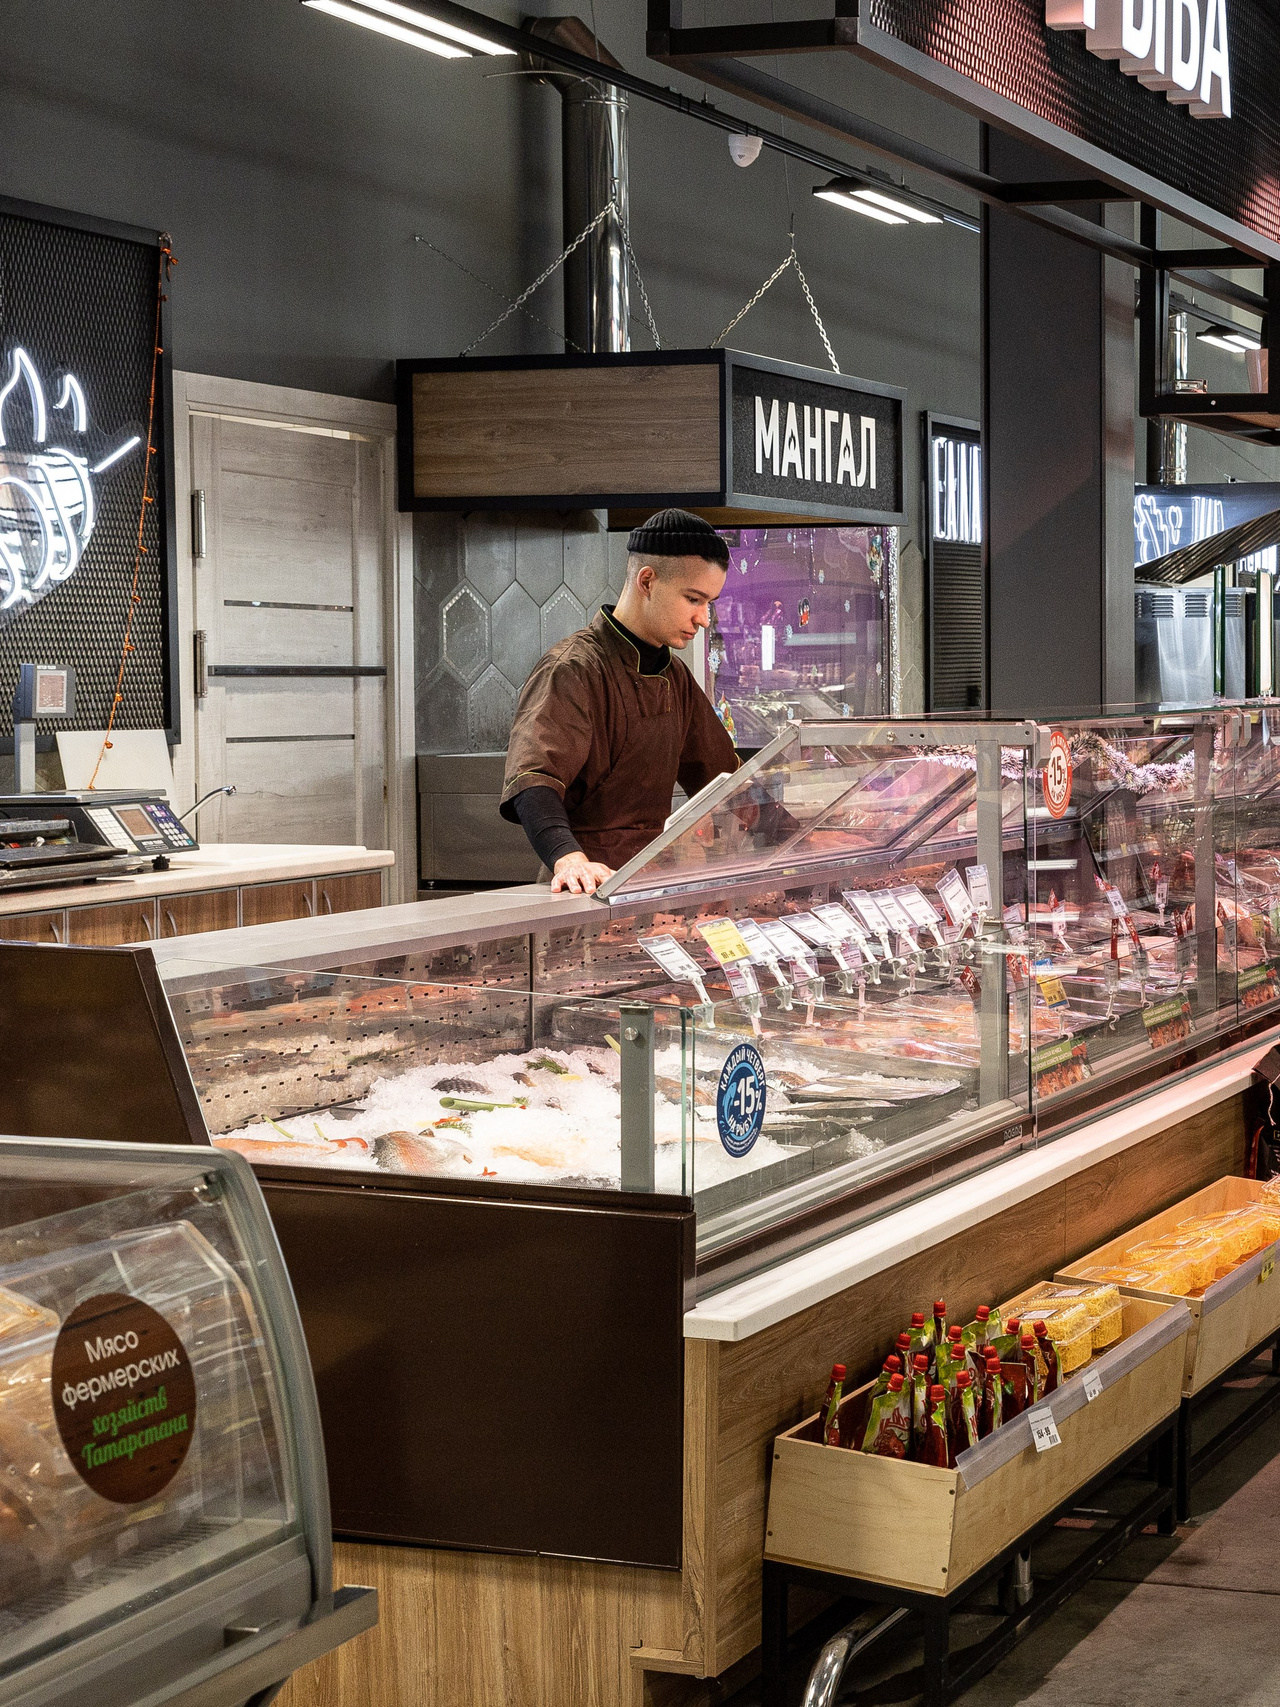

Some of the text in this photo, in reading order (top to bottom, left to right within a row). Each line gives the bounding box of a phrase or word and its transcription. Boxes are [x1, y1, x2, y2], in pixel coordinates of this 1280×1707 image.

[754, 395, 877, 490] МАНГАЛ
[720, 1045, 765, 1091] КАЖДЫЙ ЧЕТВЕРГ
[734, 1076, 763, 1115] -15%
[84, 1331, 139, 1363] Мясо
[62, 1348, 181, 1410] фермерских
[91, 1385, 168, 1436] хозяйств
[81, 1413, 188, 1469] Татарстана
